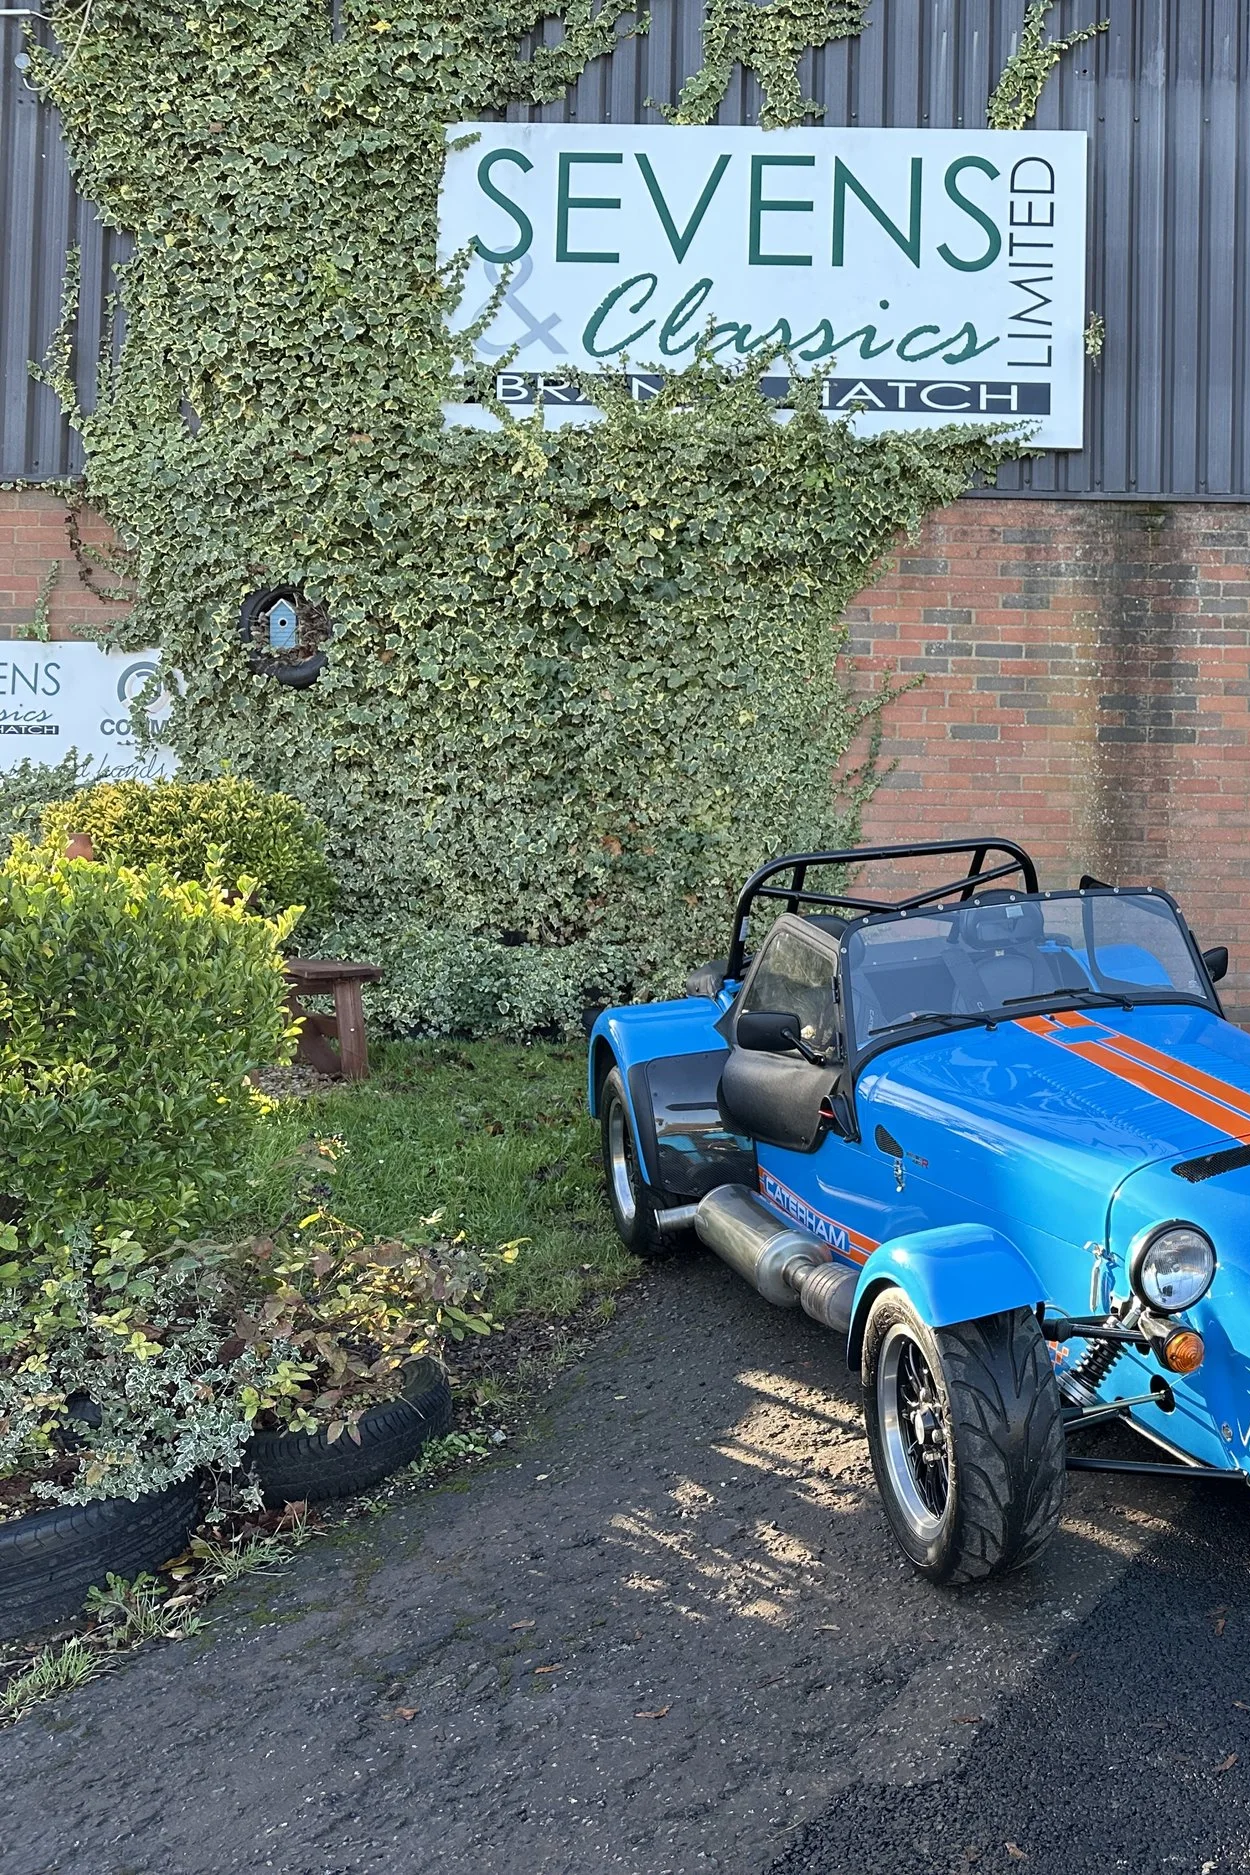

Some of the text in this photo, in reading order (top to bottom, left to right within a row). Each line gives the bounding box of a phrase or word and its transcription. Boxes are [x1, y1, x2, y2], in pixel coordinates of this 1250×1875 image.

[468, 148, 1002, 273] SEVENS
[1007, 156, 1056, 368] LIMITED
[582, 272, 1001, 365] Classics
[765, 1176, 846, 1250] CATERHAM
